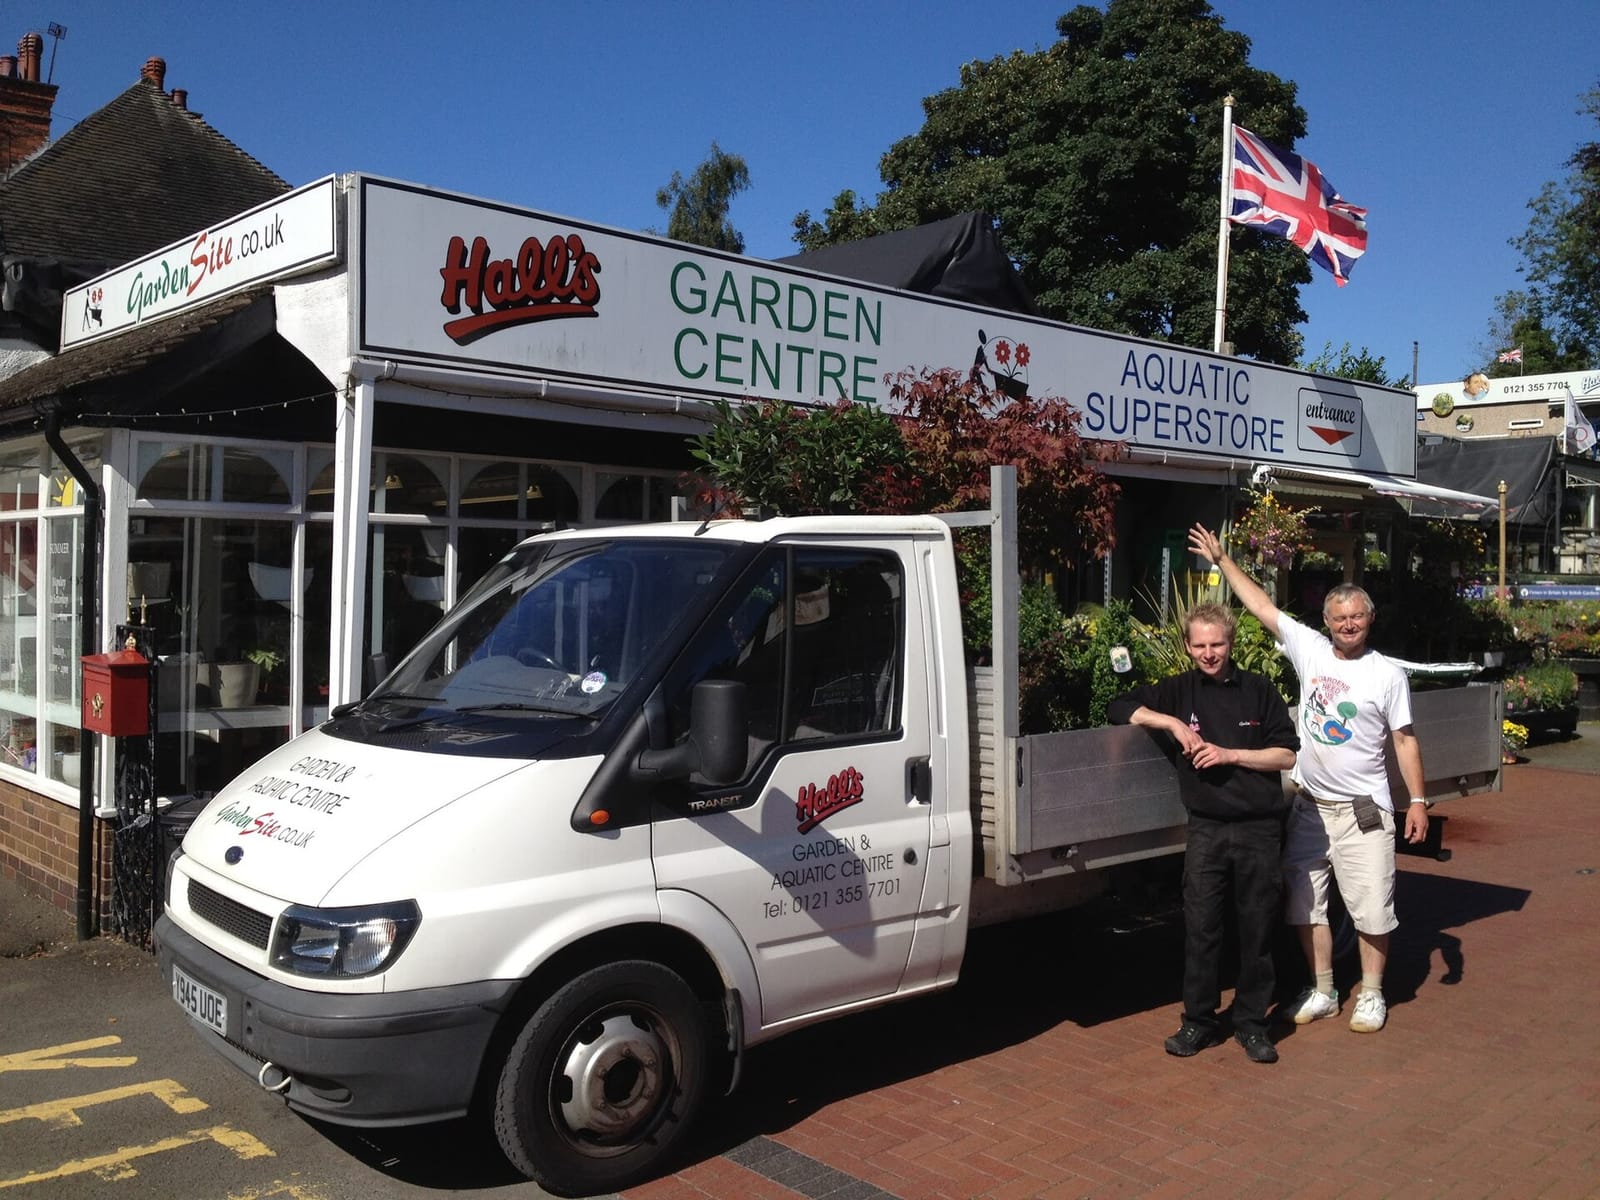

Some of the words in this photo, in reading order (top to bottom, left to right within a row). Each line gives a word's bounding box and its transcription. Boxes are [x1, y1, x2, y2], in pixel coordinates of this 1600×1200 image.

[127, 213, 284, 323] GardenSite.co.uk
[440, 234, 602, 316] Hall's
[670, 261, 882, 346] GARDEN
[674, 328, 878, 403] CENTRE
[1120, 350, 1250, 406] AQUATIC
[1503, 384, 1525, 394] 0121
[1527, 382, 1545, 392] 355
[1085, 391, 1285, 453] SUPERSTORE
[1305, 402, 1356, 424] entrance
[290, 756, 344, 780] GARDEN
[334, 766, 356, 783] &
[796, 766, 863, 821] Hall's
[248, 776, 299, 800] AQUATIC
[290, 786, 350, 814] CENTRE
[688, 795, 742, 809] TRANSIT
[792, 836, 856, 861] GARDEN
[860, 834, 871, 851] &
[771, 864, 836, 891] AQUATIC
[841, 854, 894, 878] CENTRE
[763, 900, 787, 919] Tel:
[792, 891, 828, 914] 0121
[836, 885, 863, 905] 355
[868, 878, 901, 898] 7701
[175, 971, 197, 1013] Y945
[200, 989, 222, 1028] UOE
